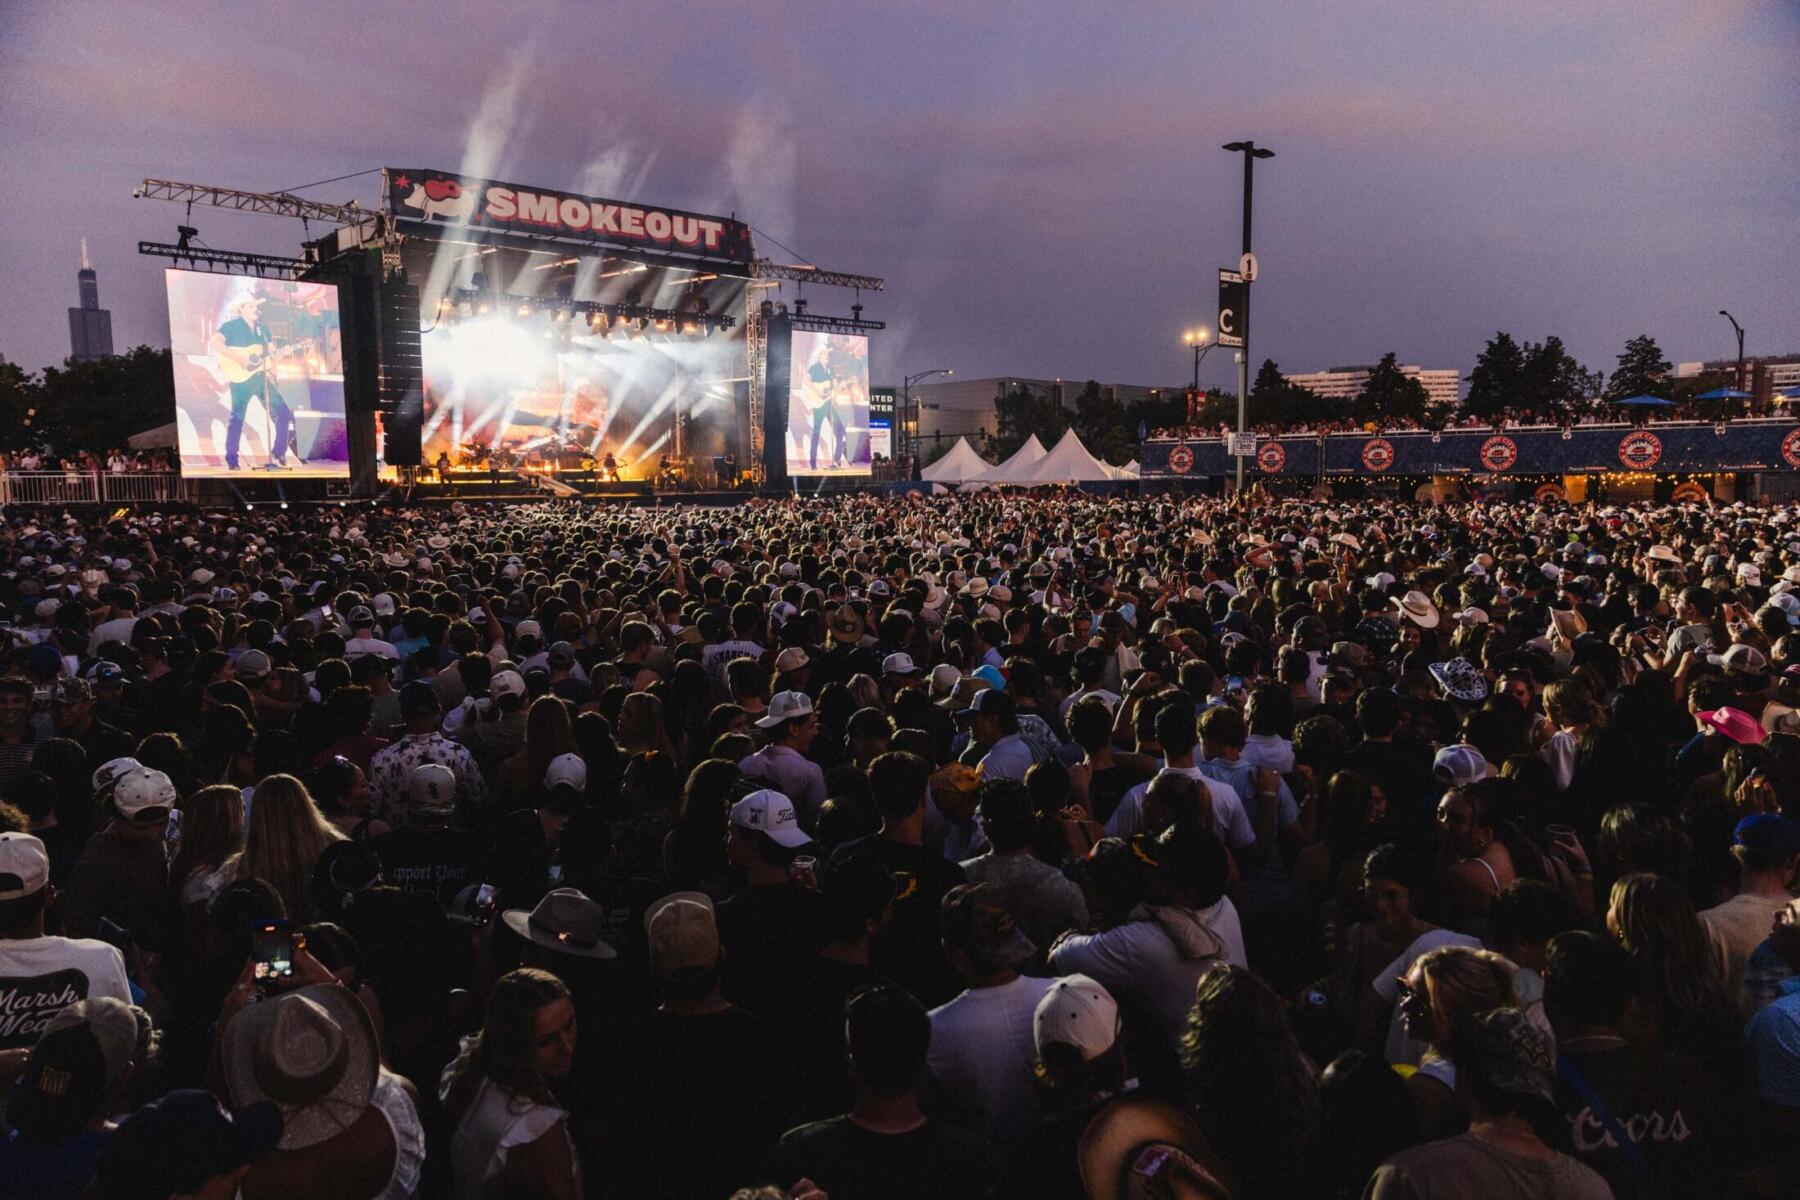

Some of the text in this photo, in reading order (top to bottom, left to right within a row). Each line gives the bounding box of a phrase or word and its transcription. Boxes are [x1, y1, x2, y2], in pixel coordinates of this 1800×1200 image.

[485, 186, 724, 249] SMOKEOUT
[1246, 259, 1252, 272] 1
[1219, 308, 1233, 333] C
[0, 984, 78, 1015] Marsh
[0, 1011, 53, 1037] Wea
